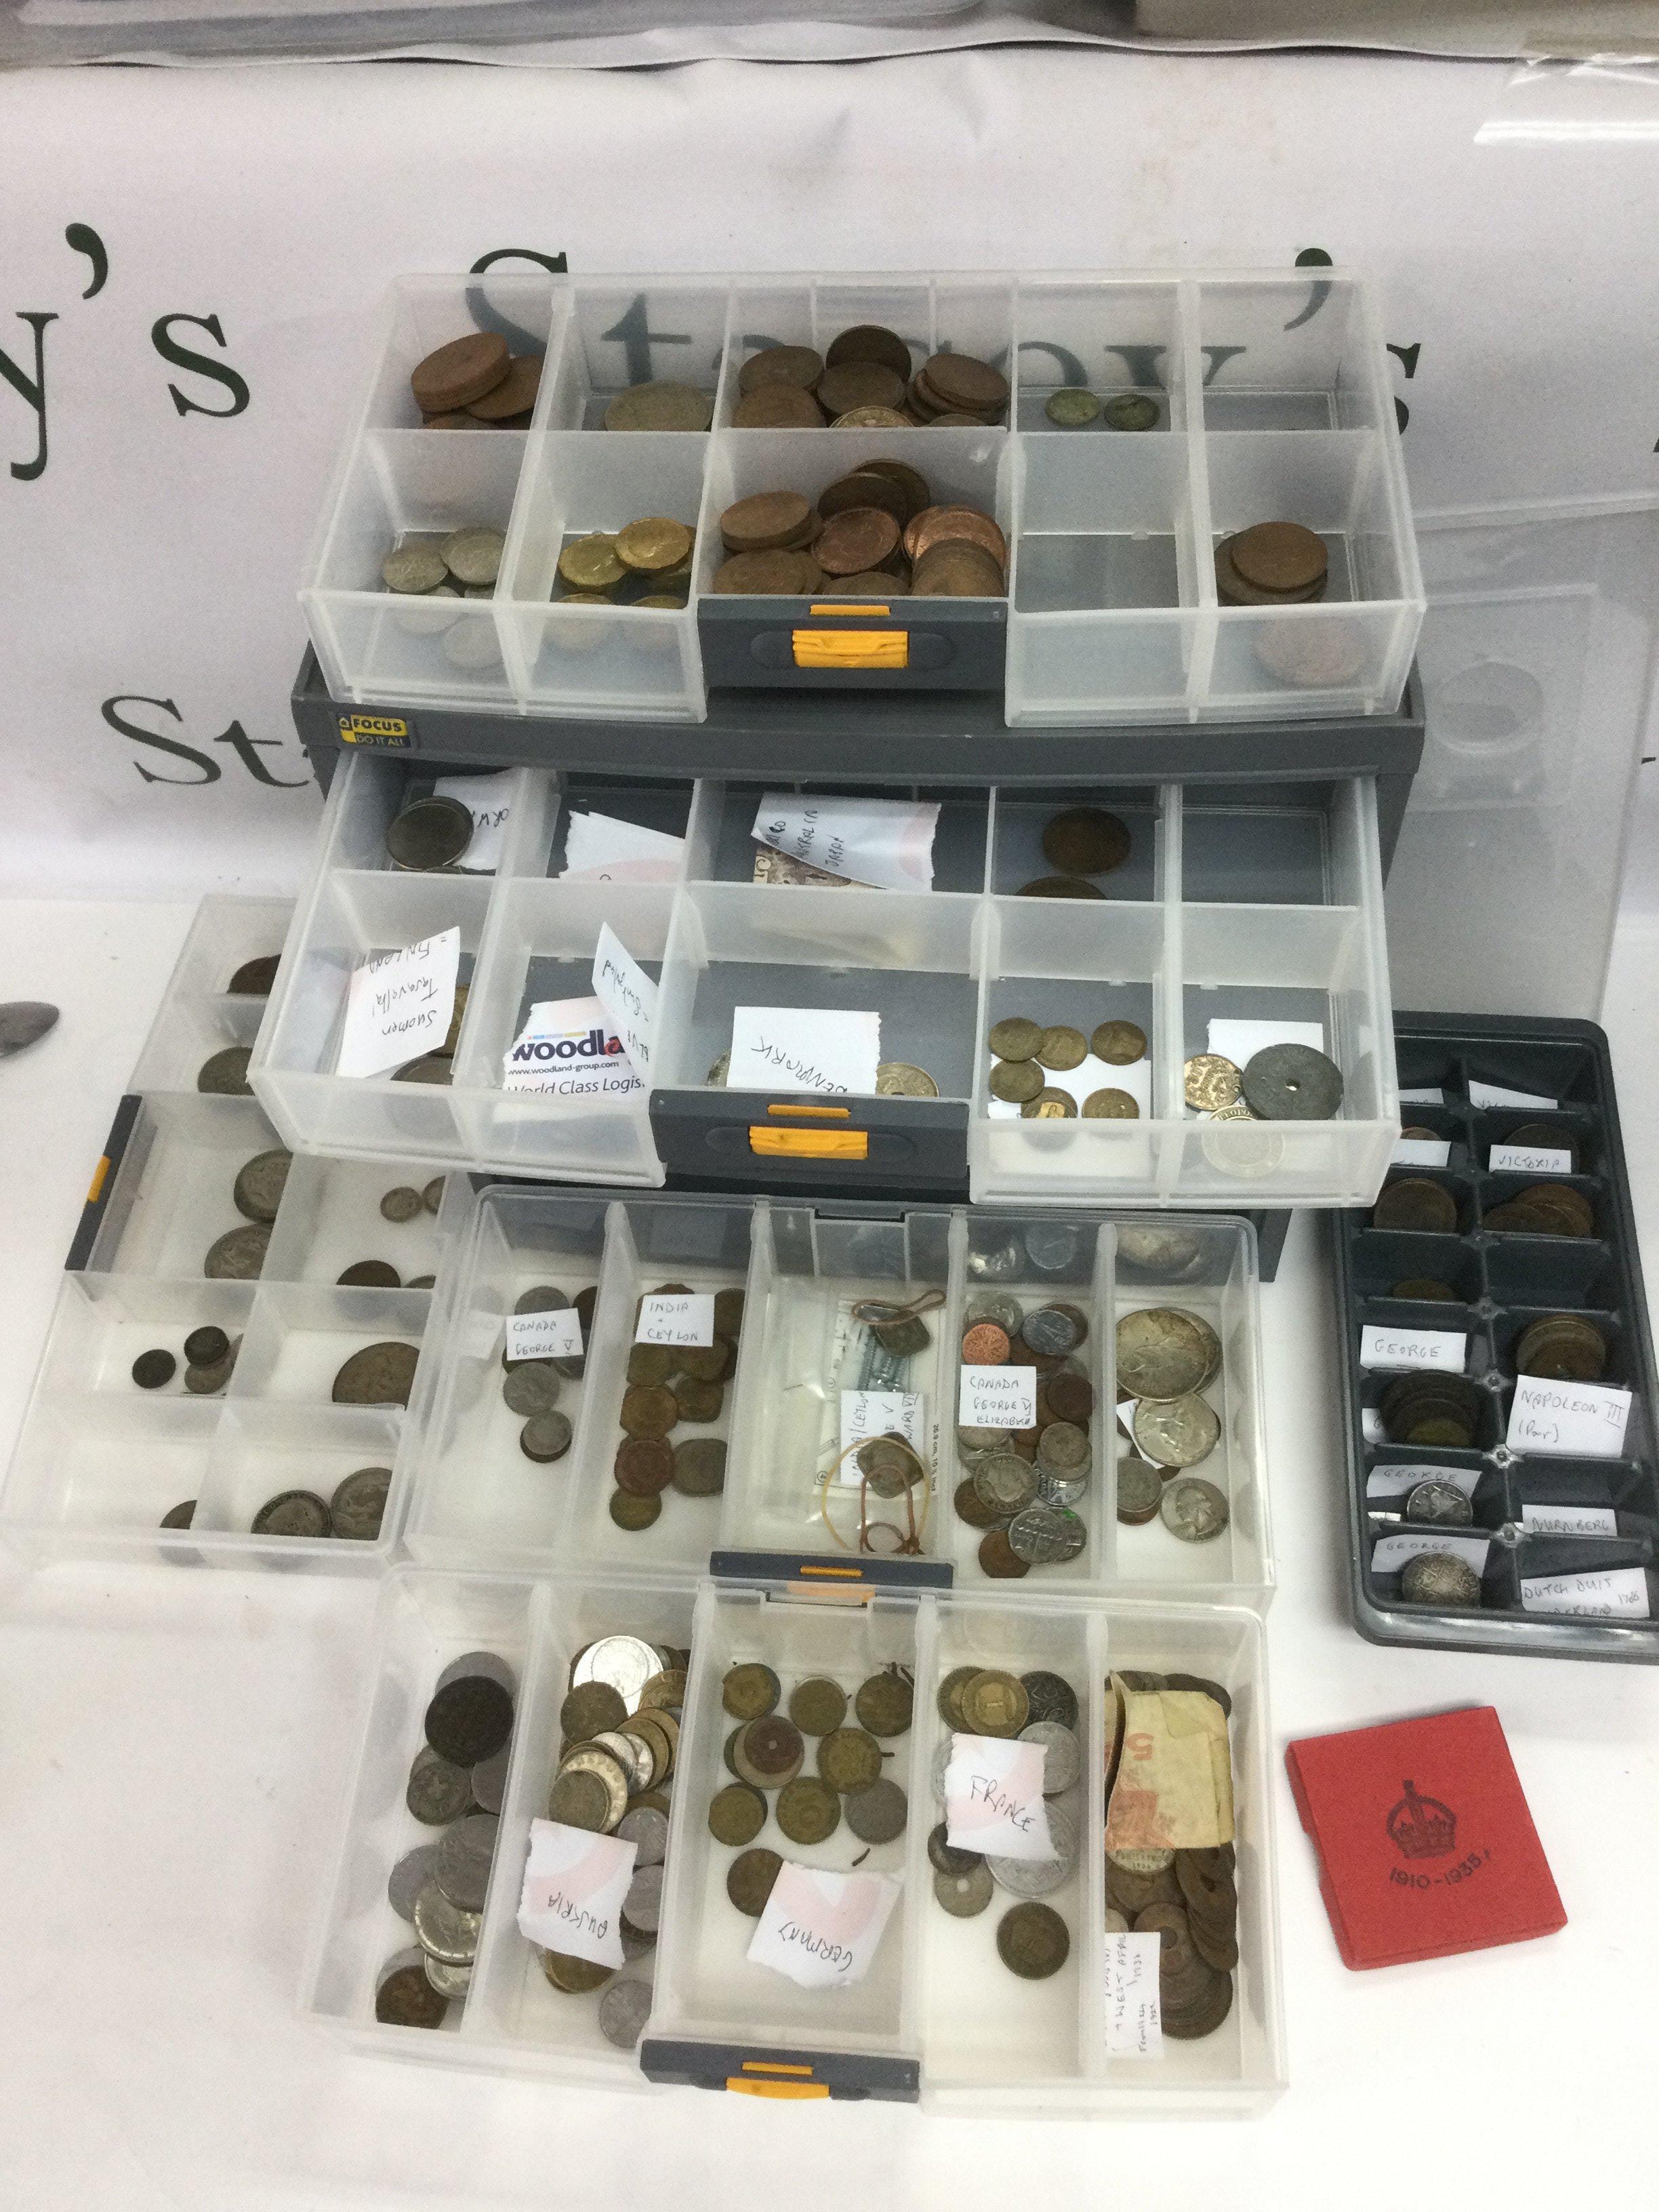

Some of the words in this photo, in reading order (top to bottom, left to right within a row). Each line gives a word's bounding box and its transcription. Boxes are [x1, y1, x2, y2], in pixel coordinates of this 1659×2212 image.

[352, 718, 403, 732] FOCUS
[356, 733, 373, 744] DO
[559, 1080, 599, 1095] Class
[603, 1075, 646, 1094] Logis
[1498, 1155, 1561, 1170] VICTORIA
[650, 1302, 689, 1313] INDIA
[513, 1320, 557, 1332] CANADA
[647, 1328, 699, 1342] CEYLON
[516, 1343, 556, 1356] GEORGE
[1374, 1338, 1442, 1357] GEORGE
[969, 1375, 1020, 1390] CANADA
[973, 1396, 1018, 1410] GEORGE
[1521, 1390, 1597, 1414] NAPOLEON
[1383, 1469, 1458, 1482] GEORGE
[1387, 1541, 1452, 1551] GEORGE
[970, 1775, 1036, 1832] FRANCE
[547, 1891, 609, 1940] AUSTRIA
[777, 1921, 853, 1972] GERMANY
